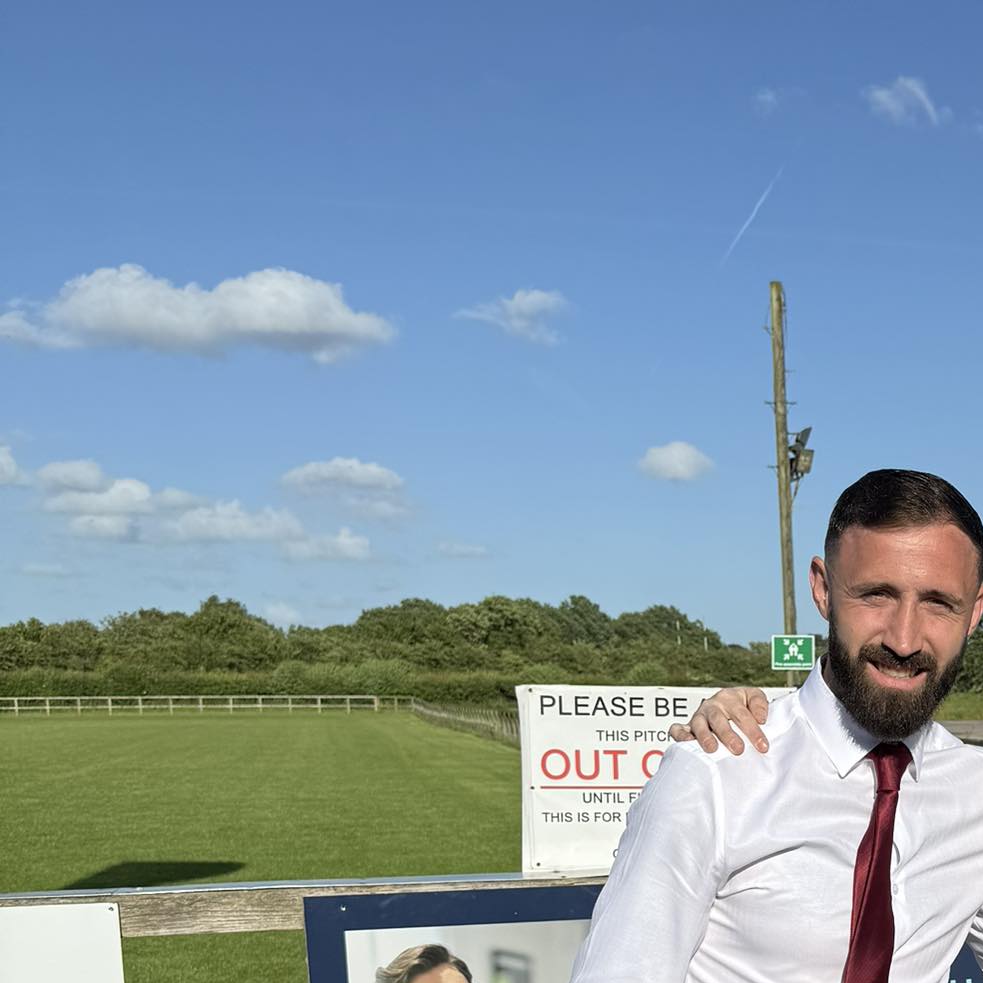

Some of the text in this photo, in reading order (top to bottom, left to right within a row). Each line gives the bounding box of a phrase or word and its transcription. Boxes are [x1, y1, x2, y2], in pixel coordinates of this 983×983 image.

[540, 695, 645, 716] PLEASE
[655, 697, 688, 717] BE
[597, 730, 630, 742] THIS
[540, 749, 628, 780] OUT
[583, 792, 625, 804] UNTIL
[542, 812, 574, 823] THIS
[577, 812, 590, 823] IS
[594, 812, 622, 823] FOR
